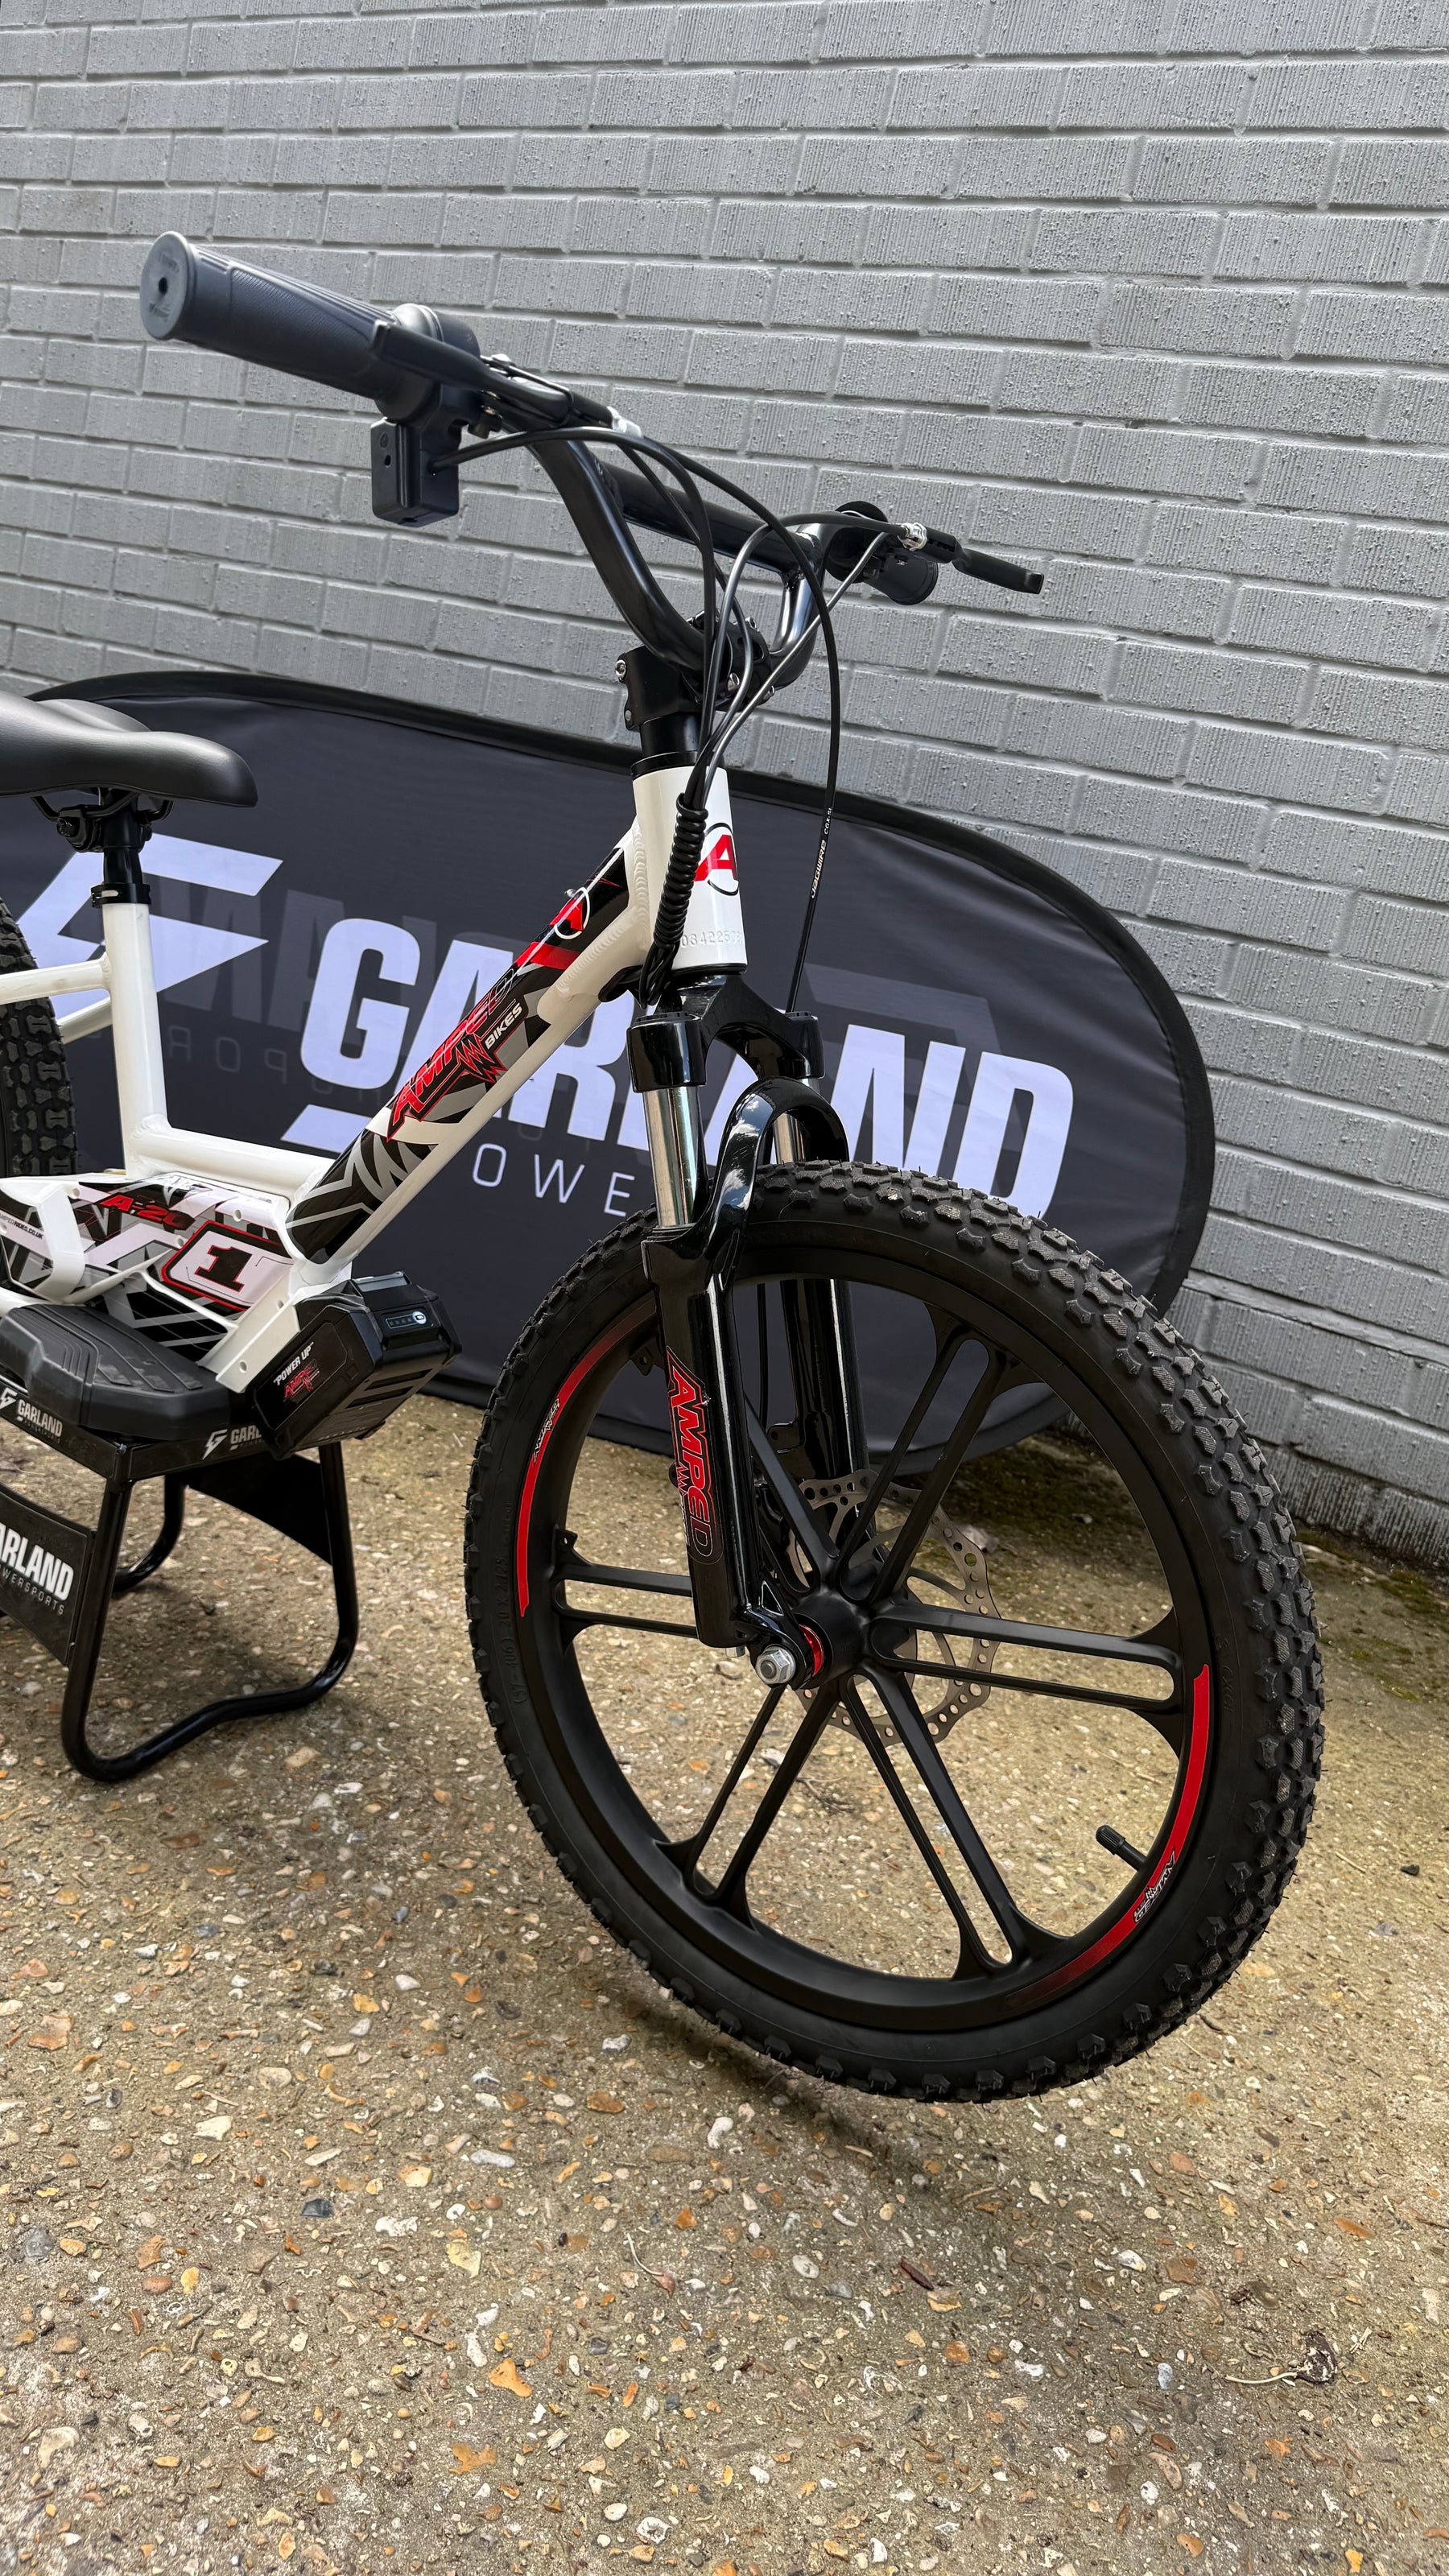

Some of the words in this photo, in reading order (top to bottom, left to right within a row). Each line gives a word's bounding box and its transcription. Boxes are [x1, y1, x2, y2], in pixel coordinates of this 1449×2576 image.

[485, 1002, 522, 1050] BIKES
[194, 1245, 245, 1293] 1
[17, 1399, 63, 1437] GARLAND
[230, 1425, 262, 1446] GARL
[671, 1365, 713, 1557] AMPED
[2, 1568, 64, 1616] WERSPORTS
